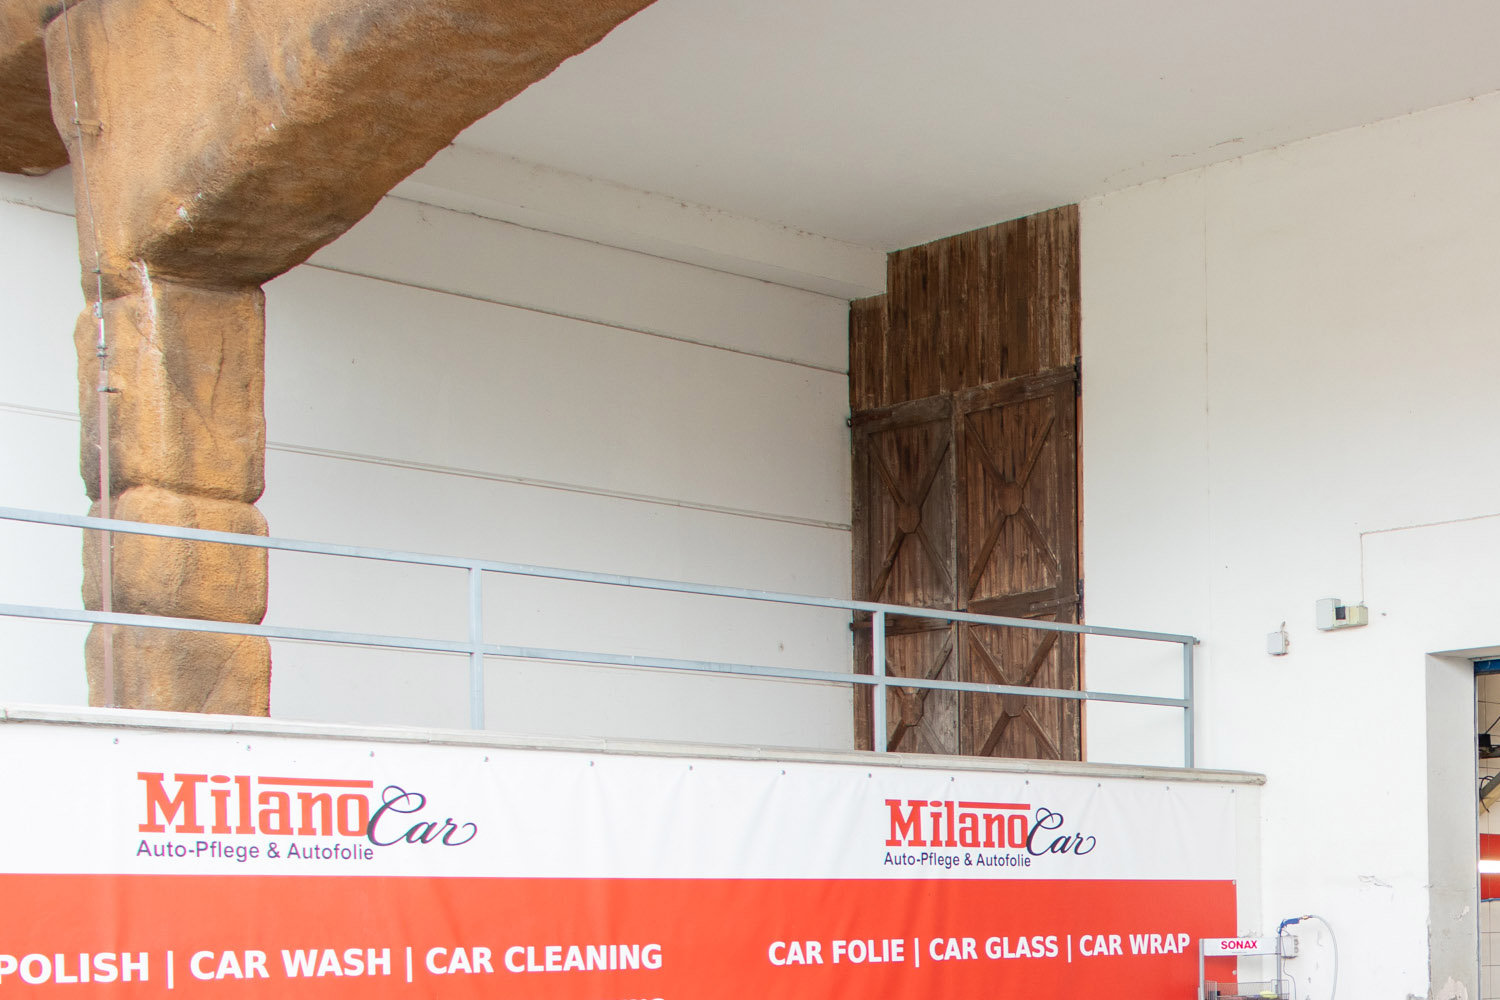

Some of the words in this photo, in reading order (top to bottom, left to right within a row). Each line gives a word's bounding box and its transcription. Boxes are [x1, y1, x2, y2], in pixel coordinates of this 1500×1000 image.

[137, 772, 374, 837] Milano
[366, 785, 478, 848] Car
[885, 799, 1031, 848] Milano
[1026, 808, 1095, 856] Car
[136, 839, 260, 863] Auto-Pflege
[267, 842, 281, 860] &
[287, 842, 374, 861] Autofolie
[884, 851, 960, 870] Auto-Pflege
[964, 853, 973, 867] &
[976, 852, 1032, 868] Autofolie
[768, 941, 823, 966] CAR
[832, 939, 905, 964] FOLIE
[929, 937, 978, 961] CAR
[986, 936, 1059, 959] GLASS
[1080, 935, 1123, 957] CAR
[1130, 933, 1190, 955] WRAP
[1221, 940, 1258, 950] SONAX
[0, 951, 149, 985] POLISH
[190, 950, 269, 980] CAR
[281, 948, 391, 978] WASH
[426, 947, 493, 975] CAR
[505, 944, 662, 973] CLEANING
